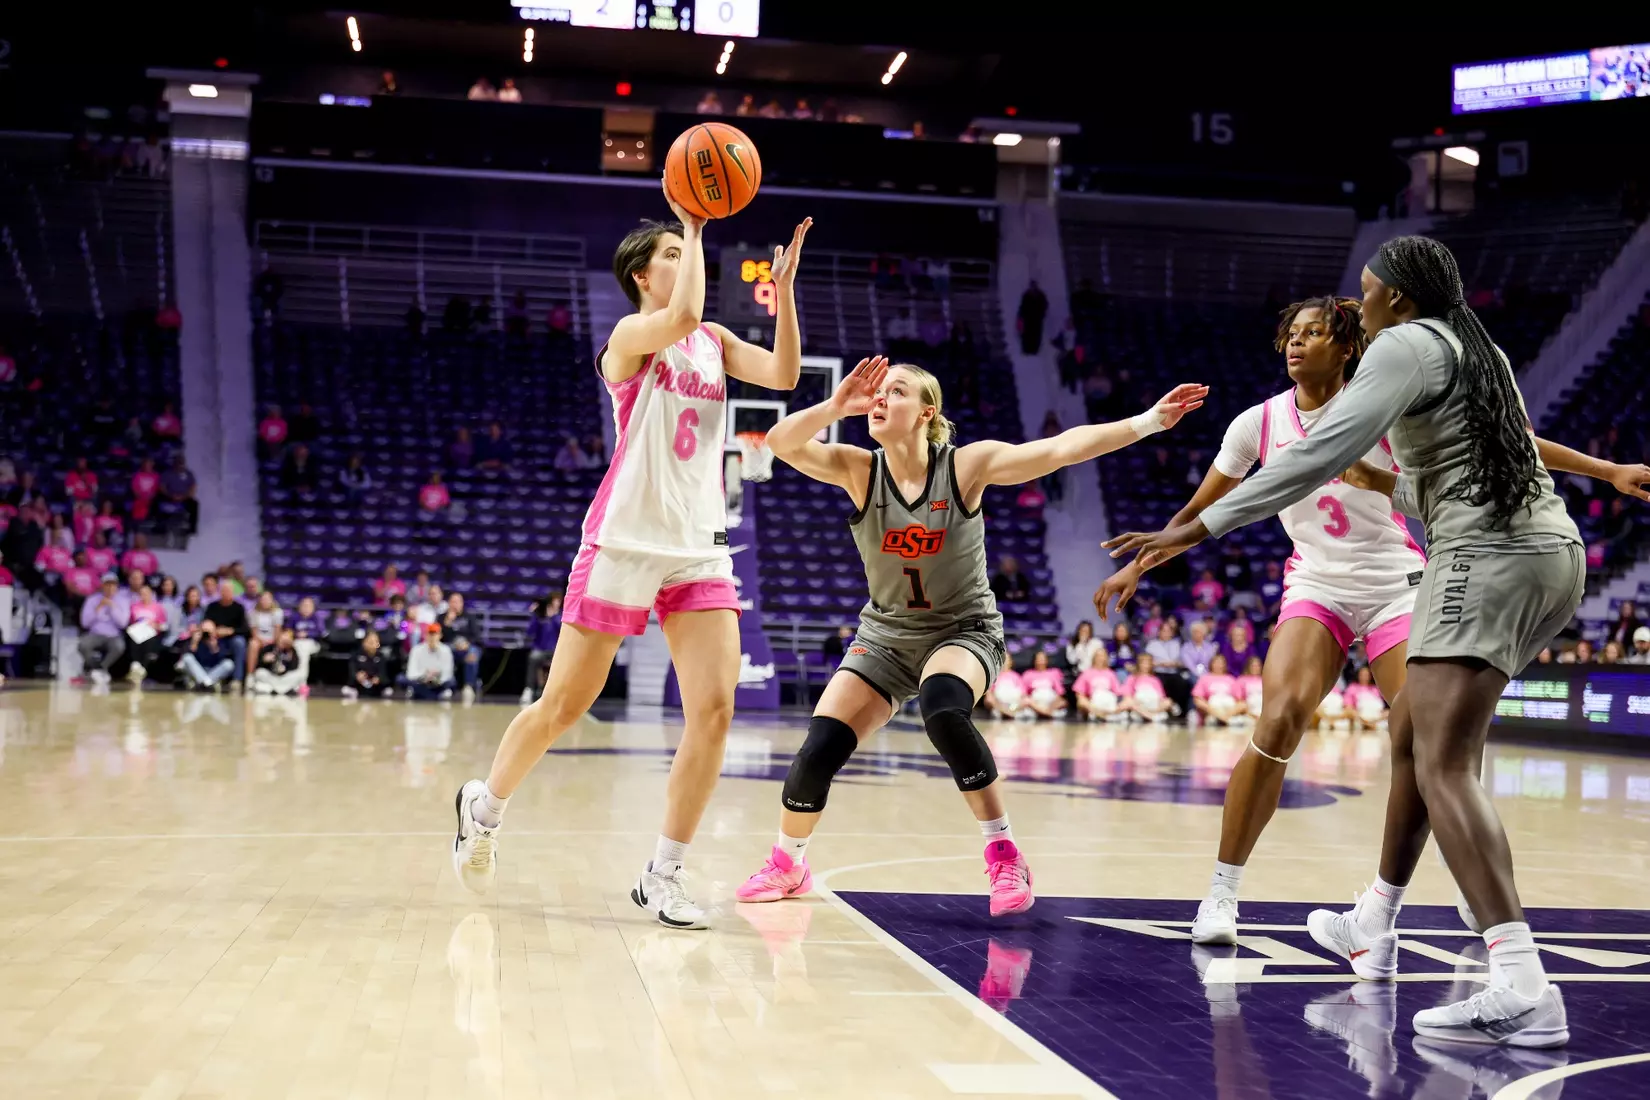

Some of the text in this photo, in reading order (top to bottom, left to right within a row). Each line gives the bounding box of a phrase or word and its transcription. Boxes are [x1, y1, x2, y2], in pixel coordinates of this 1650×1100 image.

[718, 1, 734, 23] 0
[1190, 111, 1234, 145] 15
[696, 149, 722, 201] ELITE
[755, 282, 777, 316] 9
[655, 361, 724, 402] Wldcats
[673, 407, 699, 461] 6
[1316, 495, 1351, 538] 3
[881, 524, 947, 560] OSU
[903, 567, 932, 609] 1
[1451, 563, 1471, 573] &
[1440, 576, 1469, 624] LOYAL
